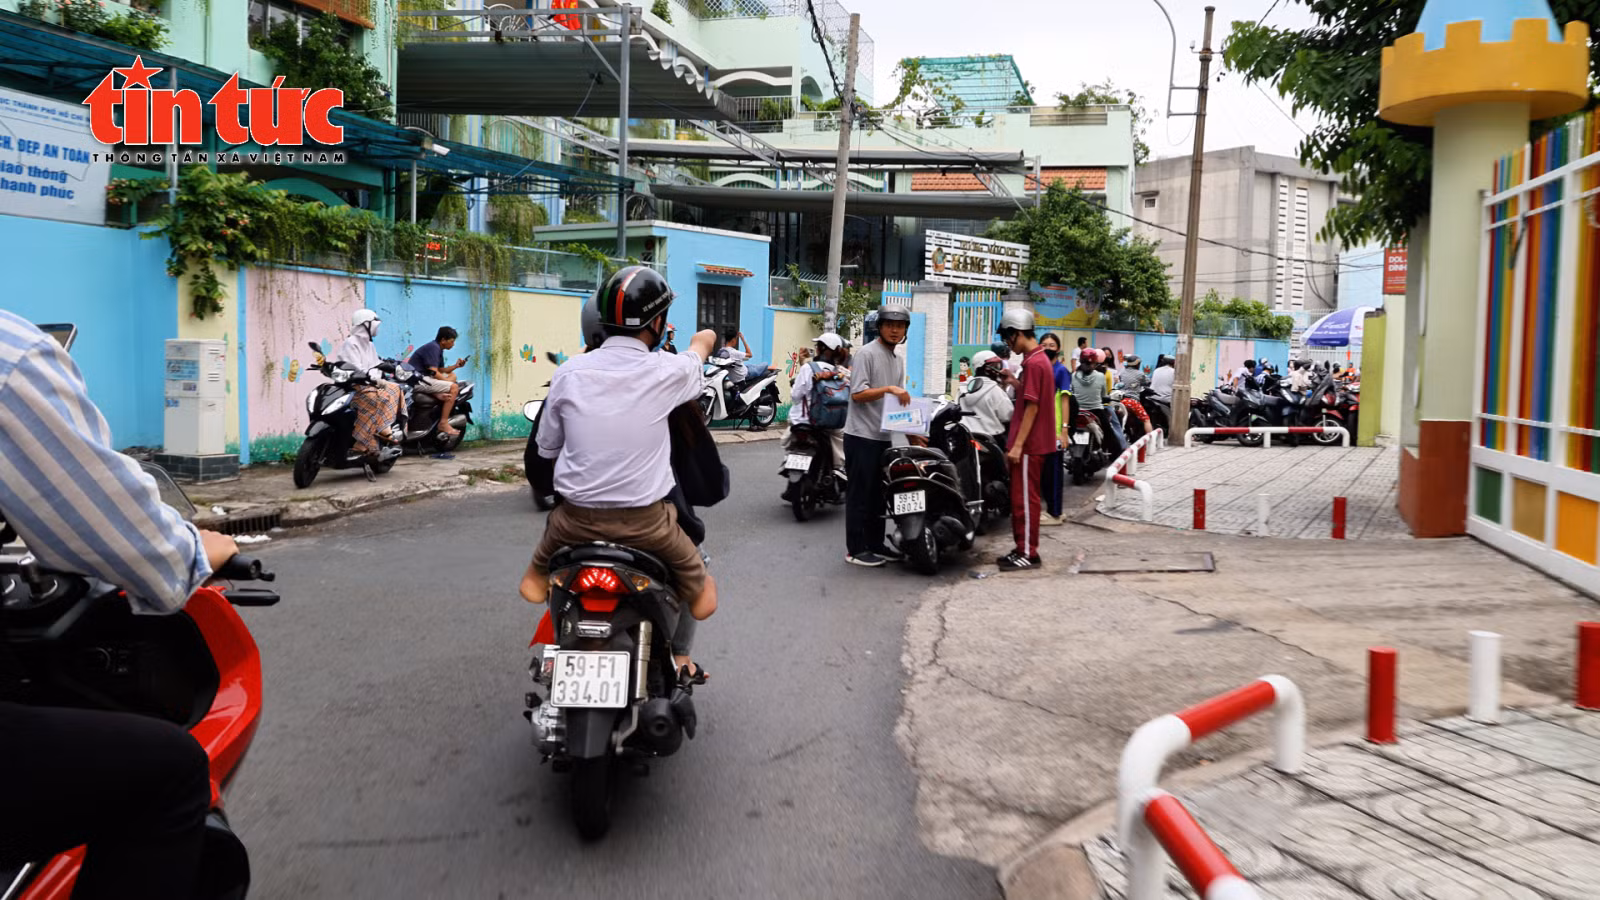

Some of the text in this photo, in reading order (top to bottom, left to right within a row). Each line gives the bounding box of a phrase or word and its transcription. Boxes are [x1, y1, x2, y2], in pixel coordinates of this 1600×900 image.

[43, 143, 59, 158] AN
[62, 145, 90, 164] TOÀN
[28, 165, 67, 184] thông
[40, 185, 75, 200] phúc
[565, 655, 616, 678] 59-F1
[556, 680, 621, 704] 334.01
